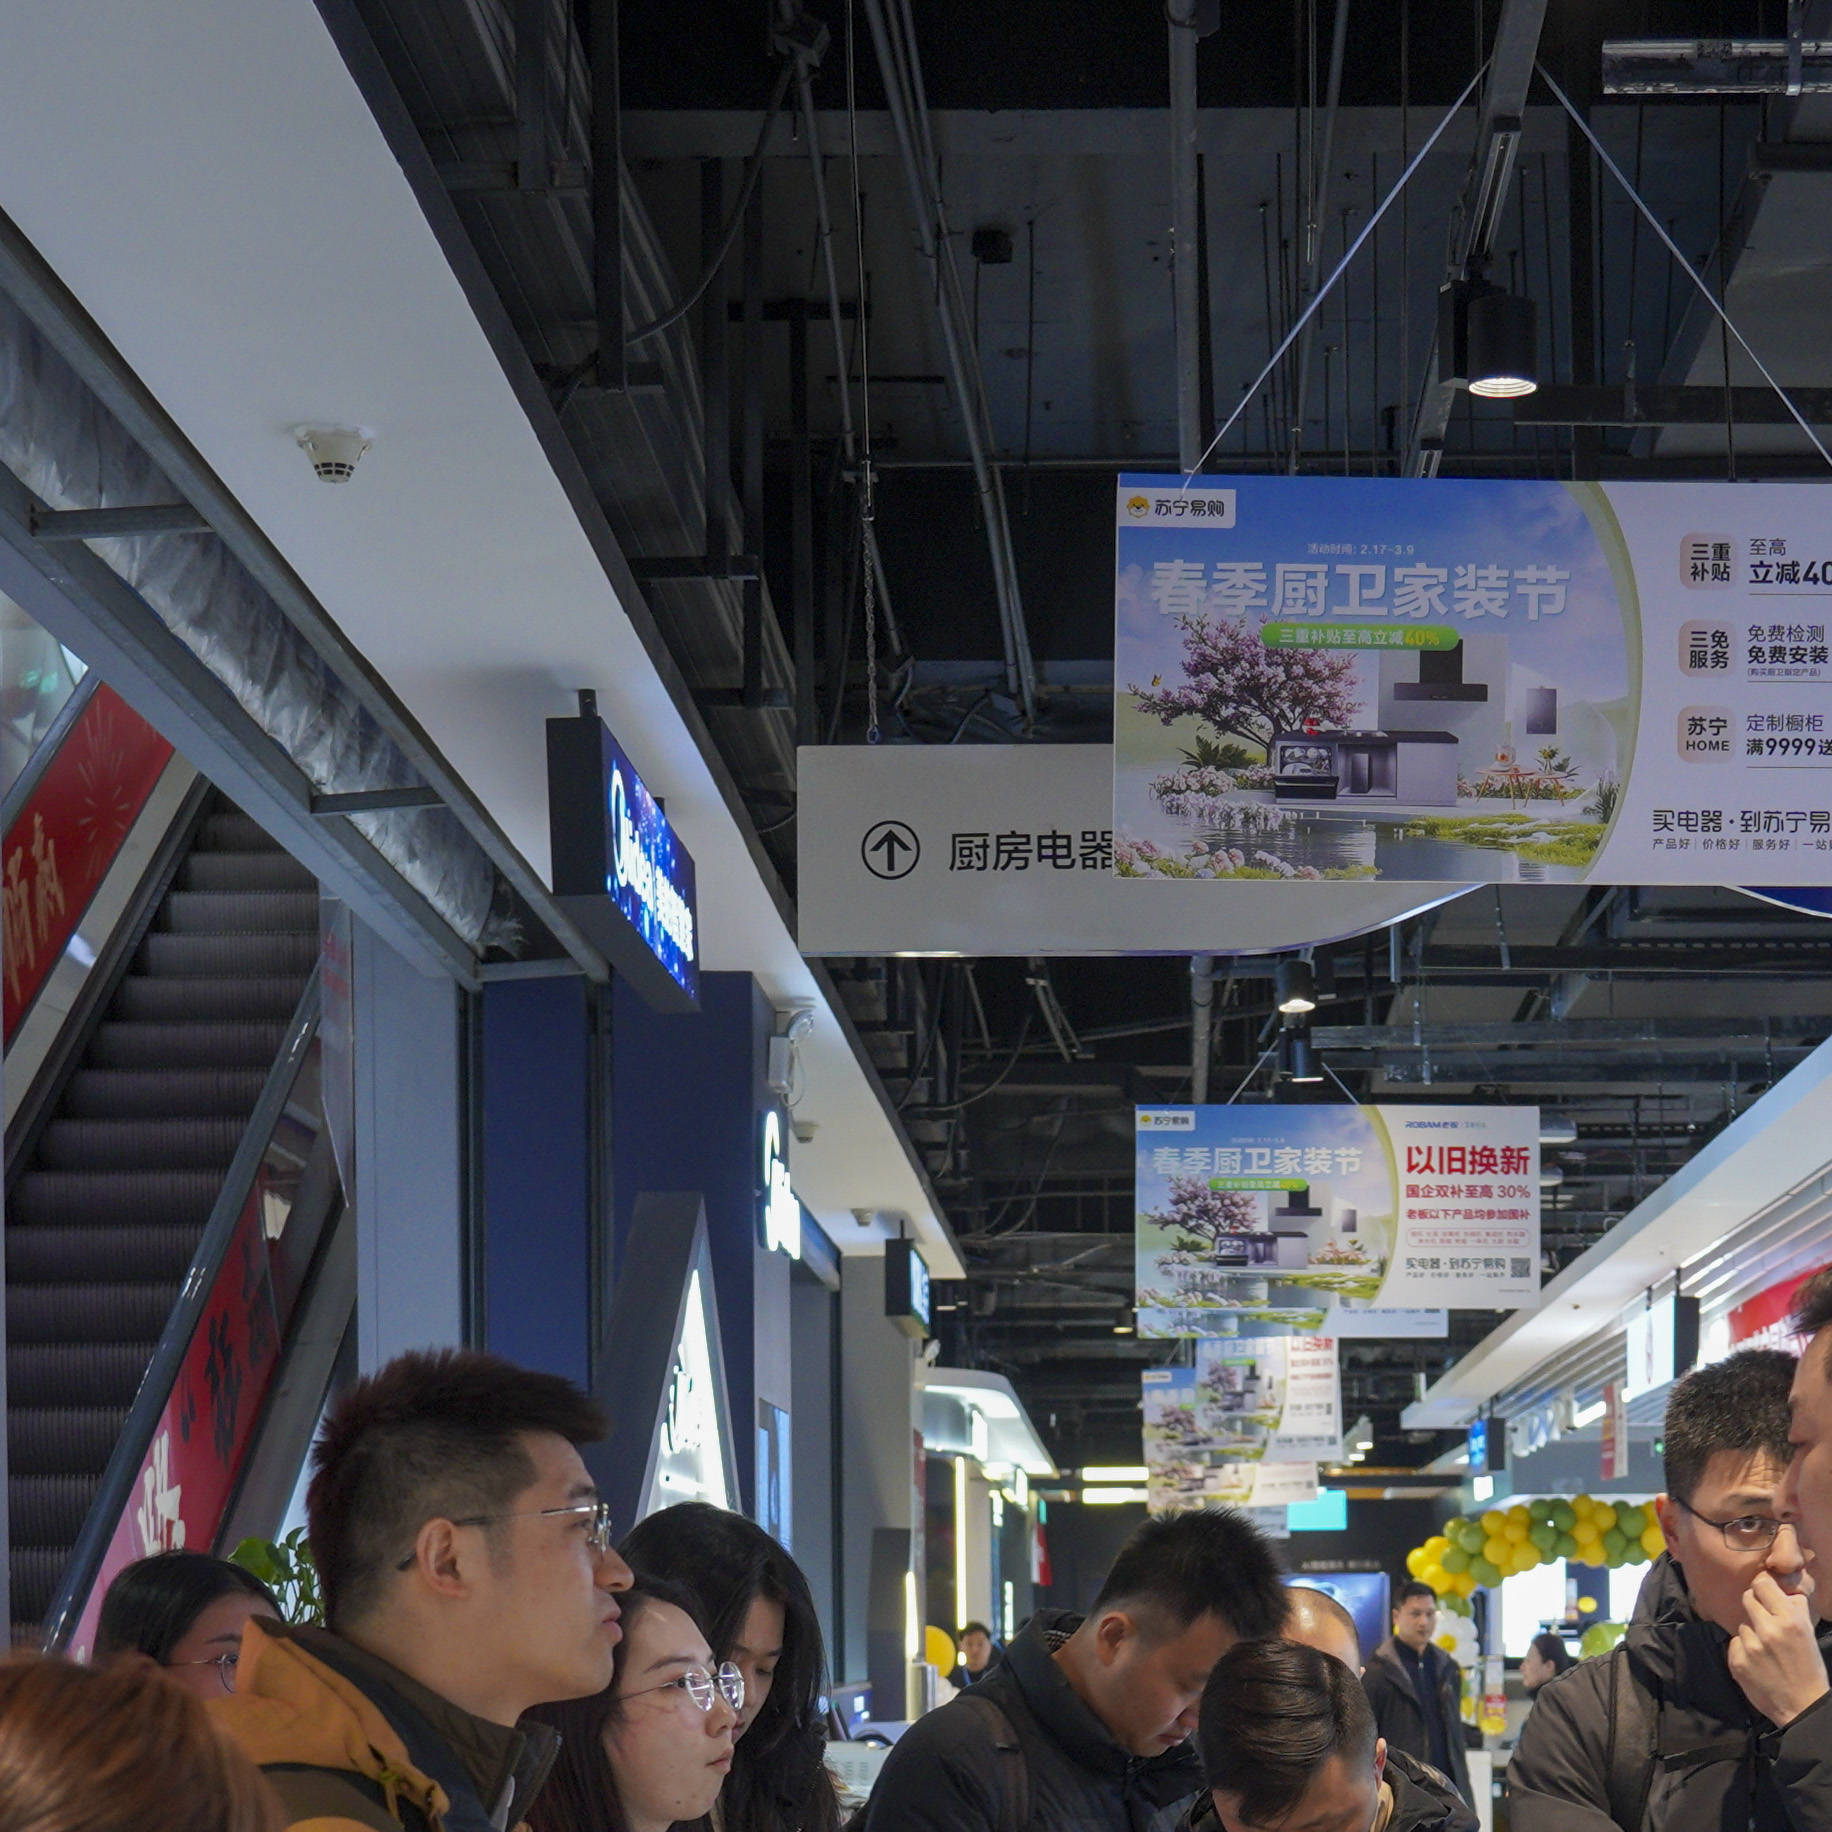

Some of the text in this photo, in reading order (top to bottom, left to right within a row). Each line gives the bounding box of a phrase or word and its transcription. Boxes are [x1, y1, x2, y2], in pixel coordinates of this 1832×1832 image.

[1154, 498, 1225, 518] 苏宁易购
[1690, 543, 1731, 562] 三重
[1749, 538, 1787, 557] 至高
[1689, 562, 1731, 583] 补贴
[1152, 558, 1571, 621] 春季厨卫家装节
[1689, 630, 1730, 649] 三免
[1747, 625, 1826, 643] 免费检测
[1688, 650, 1730, 670] 服务
[1687, 716, 1728, 737] 苏宁
[1746, 714, 1824, 733] 定制橱柜
[1686, 740, 1730, 752] HOME
[949, 829, 1113, 872] 厨房电器
[1152, 1146, 1364, 1176] 春季厨卫家装节
[1405, 1145, 1531, 1176] 以旧换新
[1497, 1185, 1531, 1199] 30%
